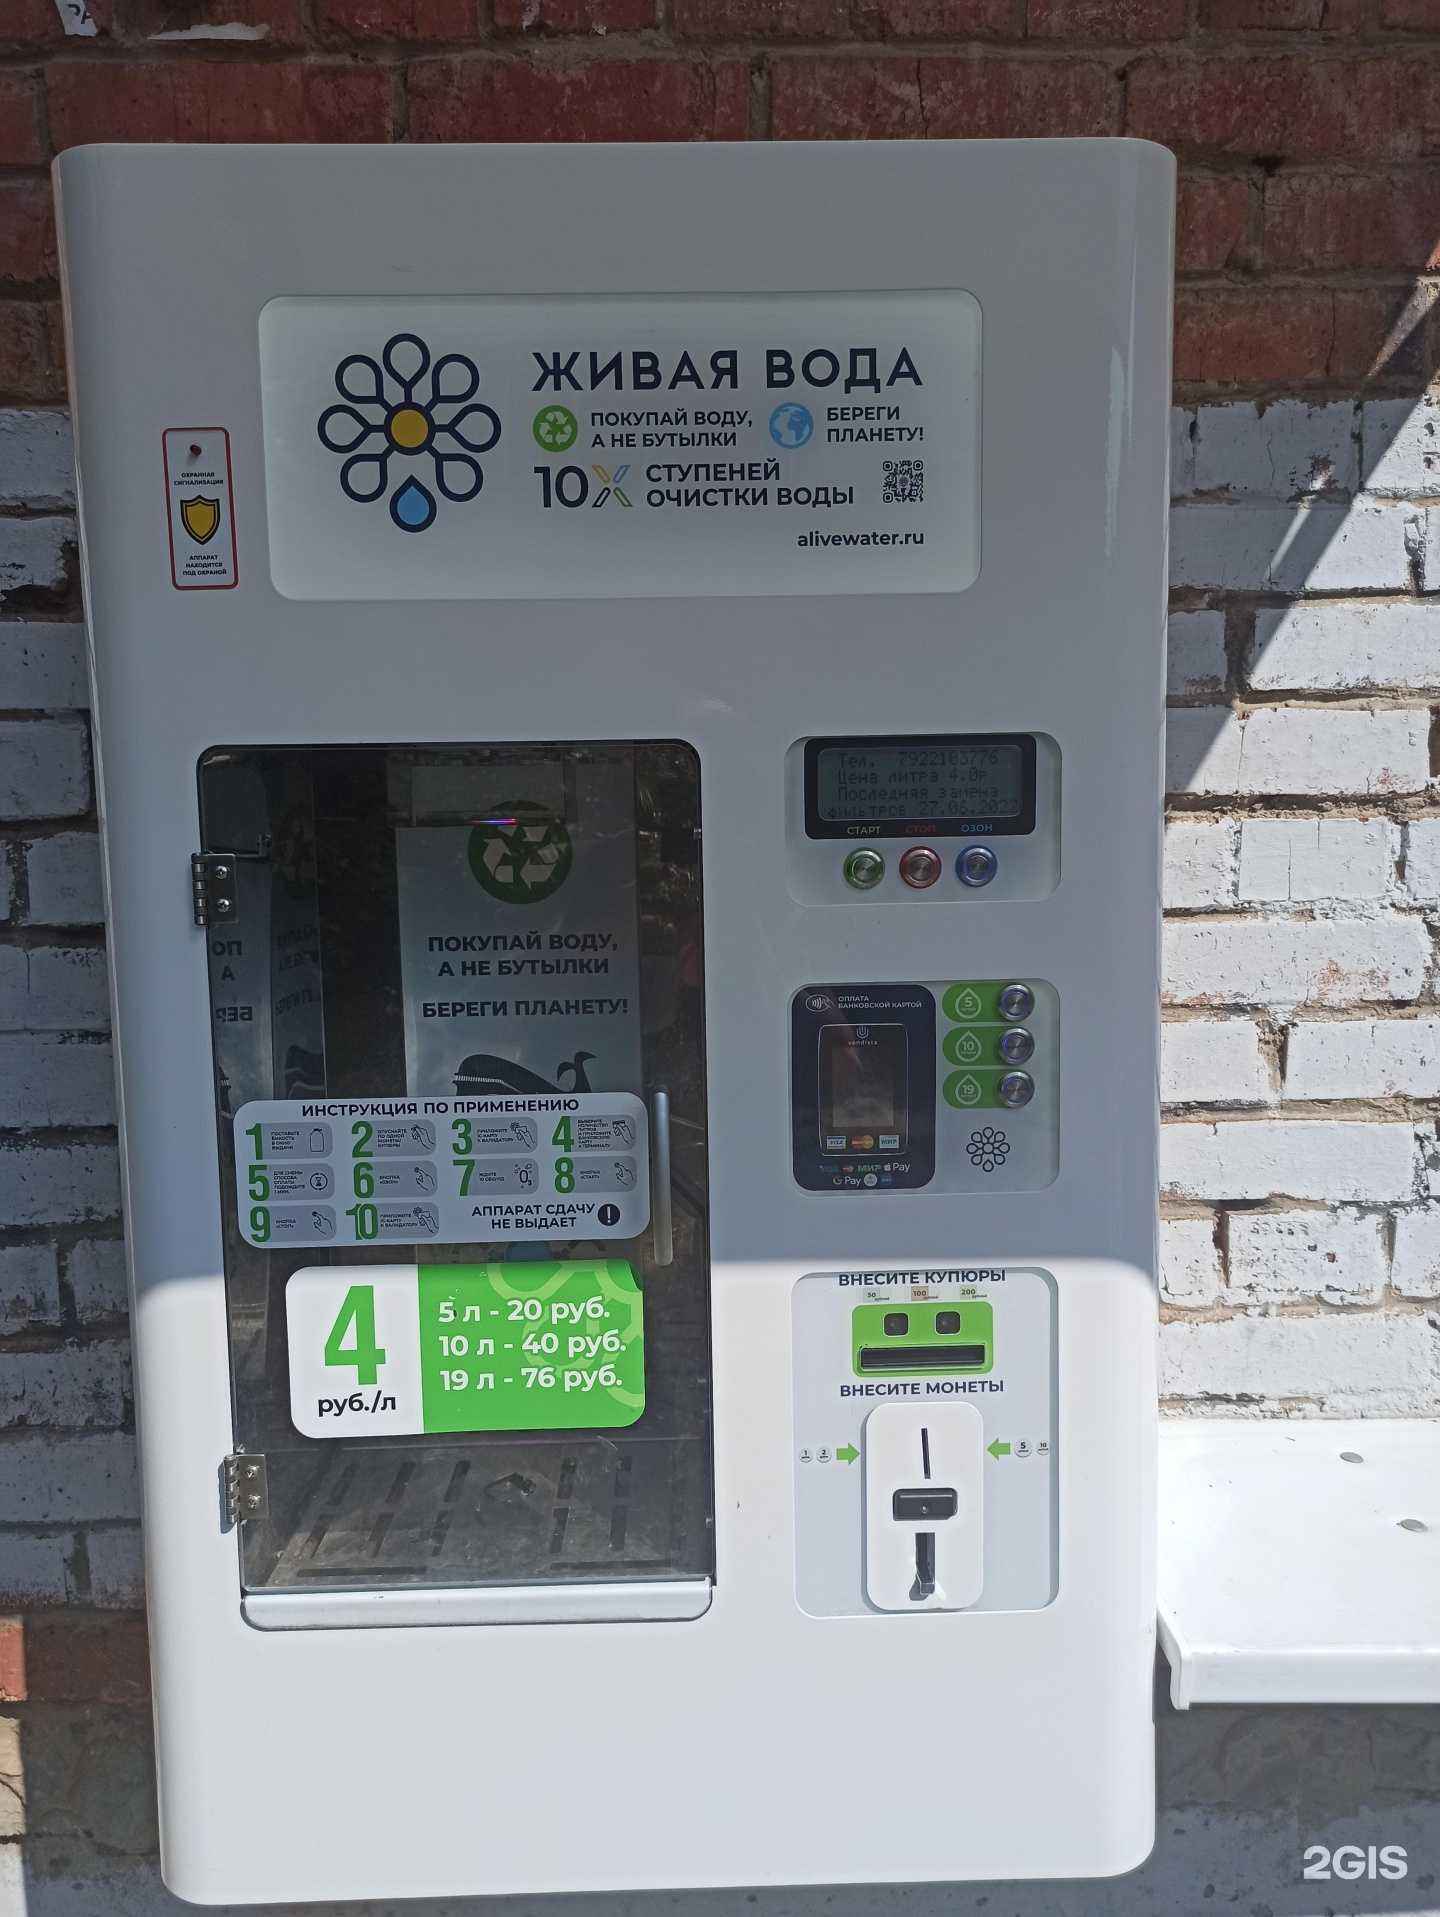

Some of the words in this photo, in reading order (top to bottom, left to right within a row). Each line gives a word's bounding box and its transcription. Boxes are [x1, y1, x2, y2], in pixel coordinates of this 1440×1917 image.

[532, 350, 738, 391] ЖИВАЯ
[765, 347, 923, 393] ВОДА
[591, 408, 688, 427] ПОКУПАЙ
[694, 409, 753, 428] ВОДУ,
[827, 405, 900, 421] БЕРЕГИ
[592, 434, 605, 448] А
[611, 433, 637, 448] НЕ
[642, 432, 737, 448] БУТЫЛКИ
[827, 426, 924, 443] ПЛАНЕТУ!
[646, 458, 780, 482] СТУПЕНЕЙ
[646, 488, 768, 508] ОЧИСТКИ
[777, 486, 854, 507] ВОДЫ
[797, 530, 924, 547] alivewater.ru
[838, 769, 878, 785] Цена
[838, 786, 928, 801] Последняя
[847, 825, 881, 835] СТАРТ
[905, 824, 936, 833] СТОП
[960, 823, 993, 833] ОЗОН
[428, 931, 541, 951] ПОКУПАЙ
[549, 932, 618, 951] ВОДУ,
[438, 961, 455, 977] А
[461, 960, 490, 976] НЕ
[499, 957, 609, 976] БУТЫЛКИ
[423, 1001, 507, 1018] БЕРЕГИ
[515, 998, 628, 1016] ПЛАНЕТУ!
[838, 995, 869, 1003] ОПЛАТА
[838, 1001, 890, 1009] БАНКОВСКОЙ
[964, 997, 973, 1007] 5
[962, 1040, 975, 1050] 10
[962, 1084, 975, 1094] 19
[302, 1103, 417, 1117] ИНСТРУКЦИЯ
[424, 1103, 449, 1115] ПО
[454, 1099, 579, 1113] ПРИМЕНЕНИЮ
[246, 1123, 263, 1160] 1
[351, 1120, 374, 1158] 2
[451, 1118, 473, 1155] 3
[552, 1115, 574, 1152] 4
[555, 1156, 575, 1193] 8
[893, 1162, 911, 1173] Pay
[248, 1165, 270, 1201] 5
[353, 1162, 375, 1198] 6
[453, 1159, 475, 1196] 7
[844, 1176, 862, 1187] Pay
[472, 1205, 541, 1216] АППАРАТ
[546, 1203, 595, 1215] СДАЧУ
[251, 1206, 271, 1242] 9
[346, 1203, 378, 1240] 10
[491, 1219, 510, 1229] НЕ
[515, 1217, 576, 1230] ВЫДАЕТ
[838, 1272, 919, 1286] ВНЕСИТЕ
[925, 1269, 1006, 1284] КУПЮРЫ
[913, 1289, 927, 1297] 100
[961, 1288, 976, 1296] 200
[438, 1300, 455, 1323] 5
[462, 1305, 481, 1322] л
[507, 1299, 542, 1321] 20
[551, 1296, 610, 1325] руб.
[324, 1285, 386, 1386] 4
[439, 1336, 469, 1357] 10
[477, 1339, 495, 1357] л
[521, 1333, 559, 1354] 40
[568, 1329, 627, 1357] руб.
[439, 1370, 469, 1391] 19
[477, 1374, 495, 1390] л
[521, 1367, 556, 1389] 76
[564, 1363, 623, 1392] руб.
[840, 1383, 920, 1397] ВНЕСИТЕ
[926, 1380, 1004, 1395] МОНЕТЫ
[317, 1391, 396, 1417] руб./л
